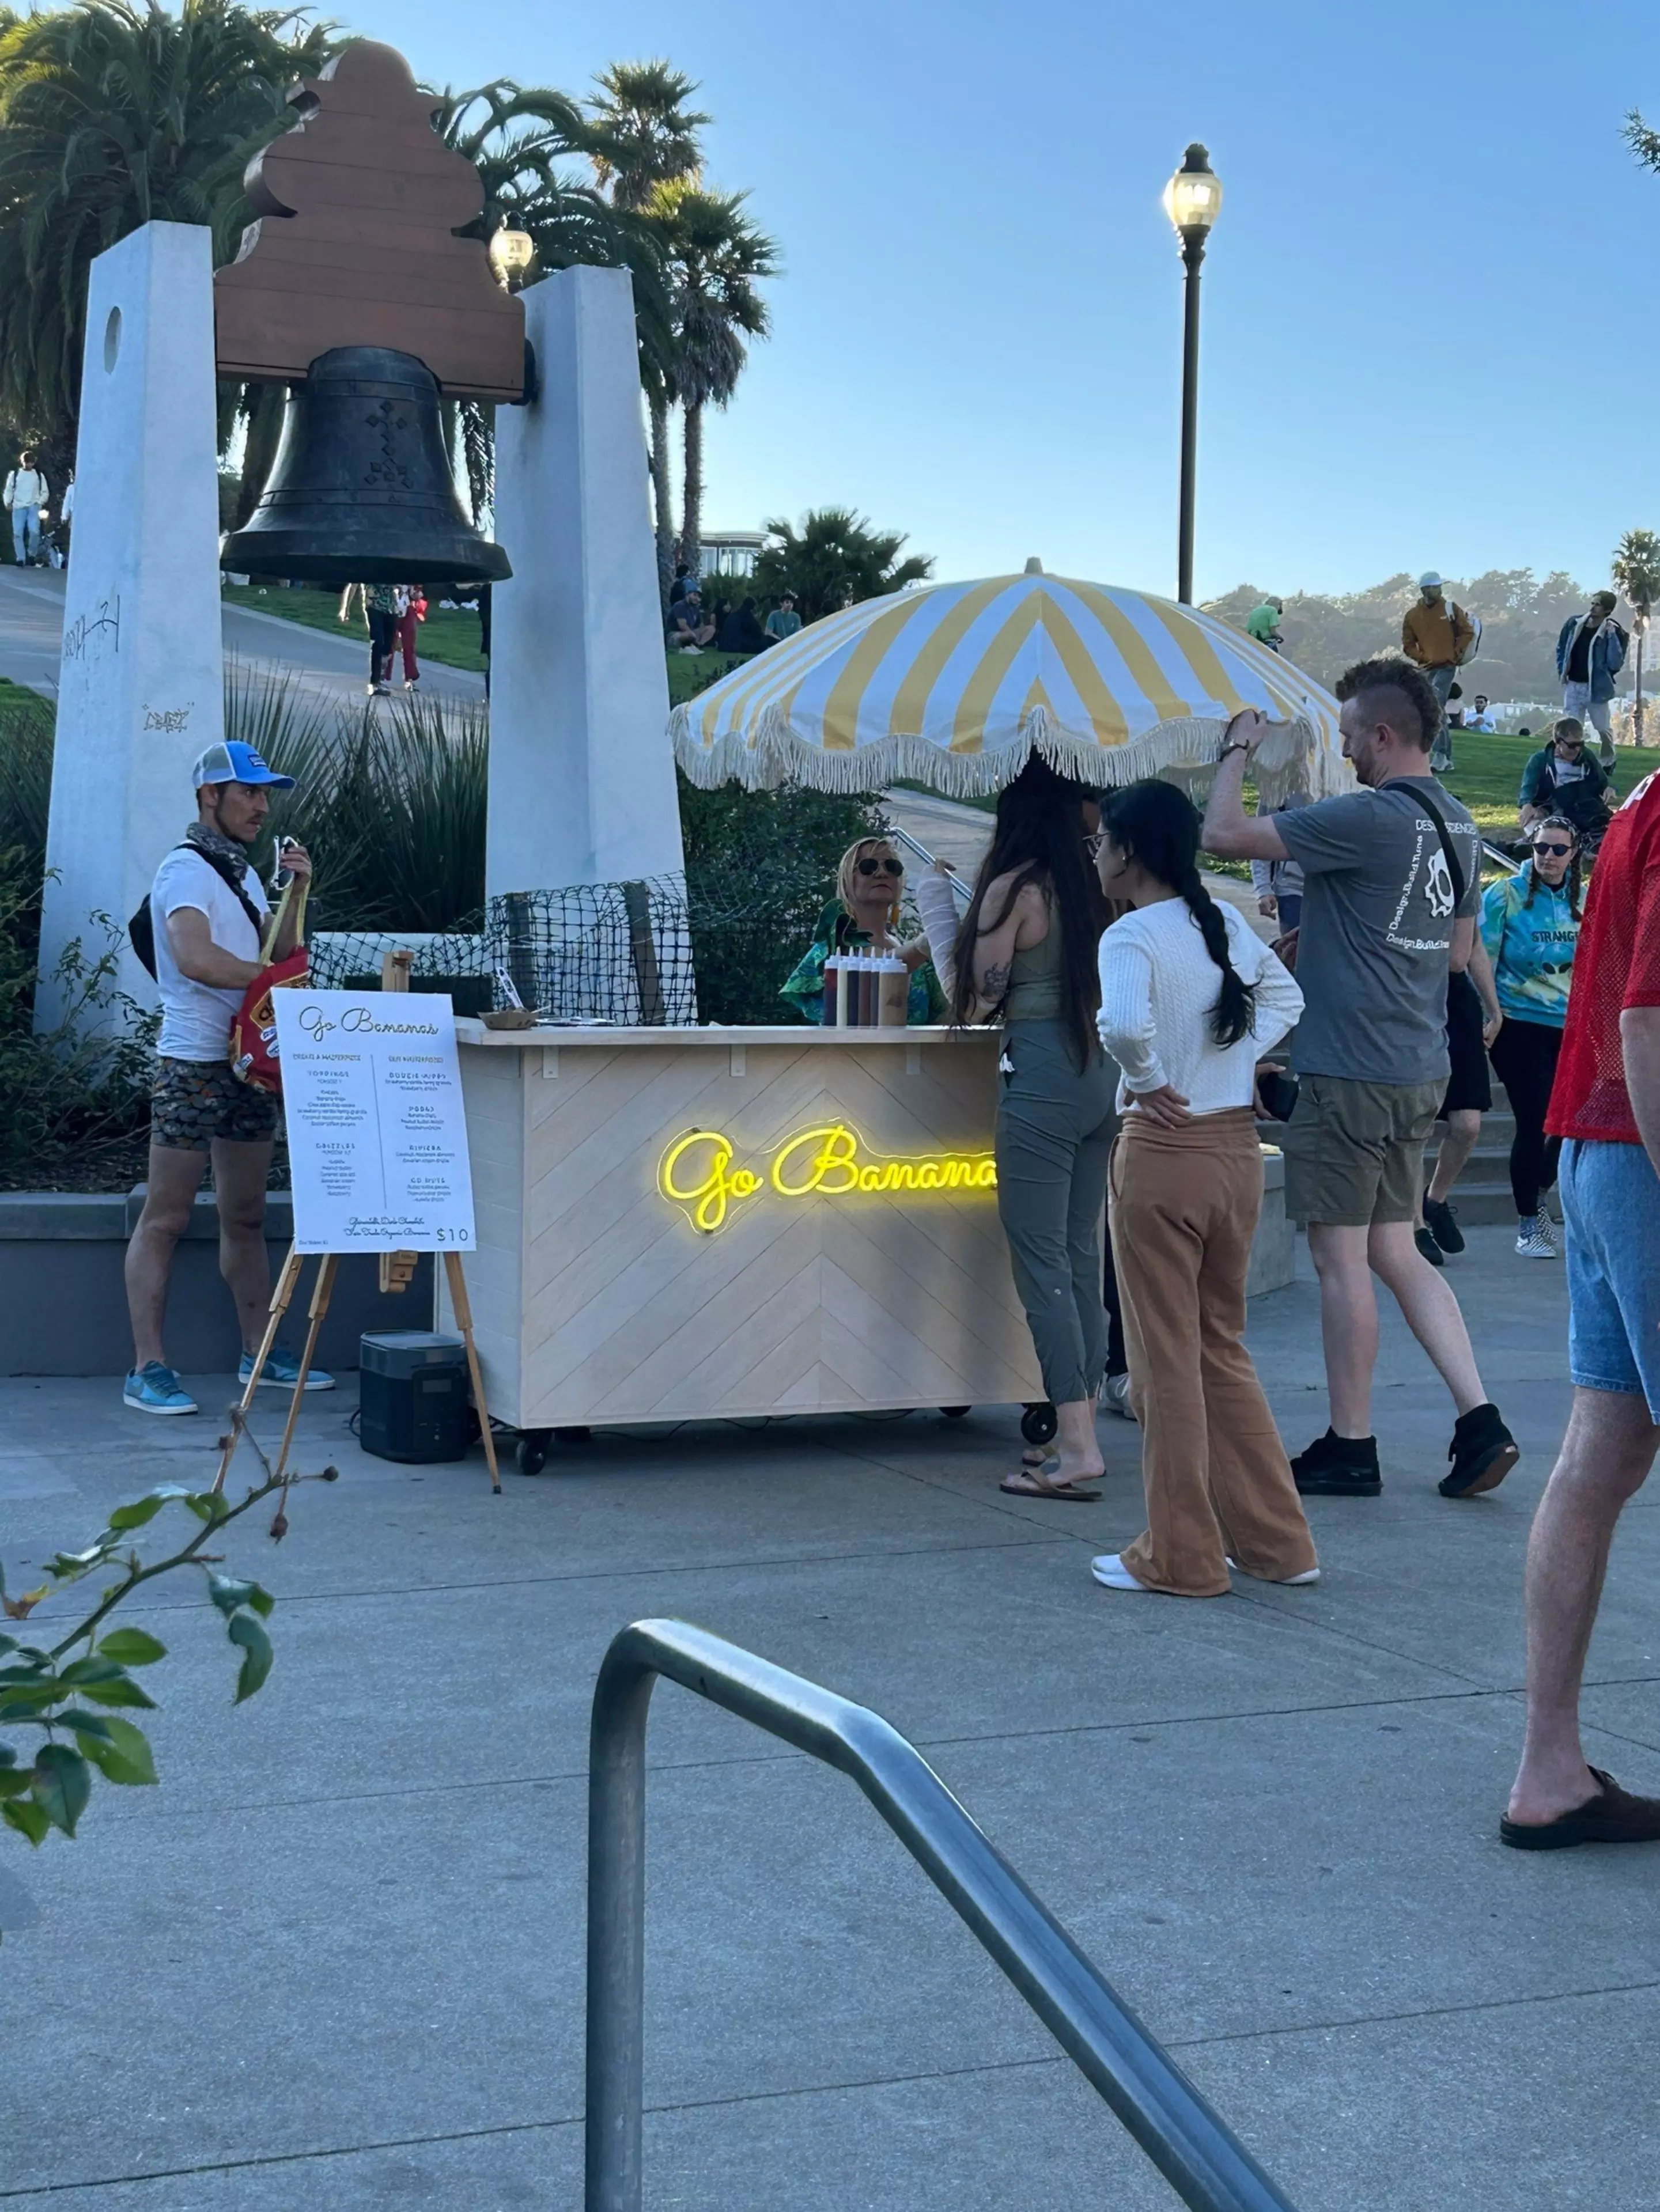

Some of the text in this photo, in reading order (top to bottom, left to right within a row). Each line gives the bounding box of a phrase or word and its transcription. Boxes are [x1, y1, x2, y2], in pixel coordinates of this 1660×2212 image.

[299, 1006, 439, 1041] Go Bananas
[664, 1124, 998, 1230] Go Banana
[436, 1228, 468, 1242] $10
